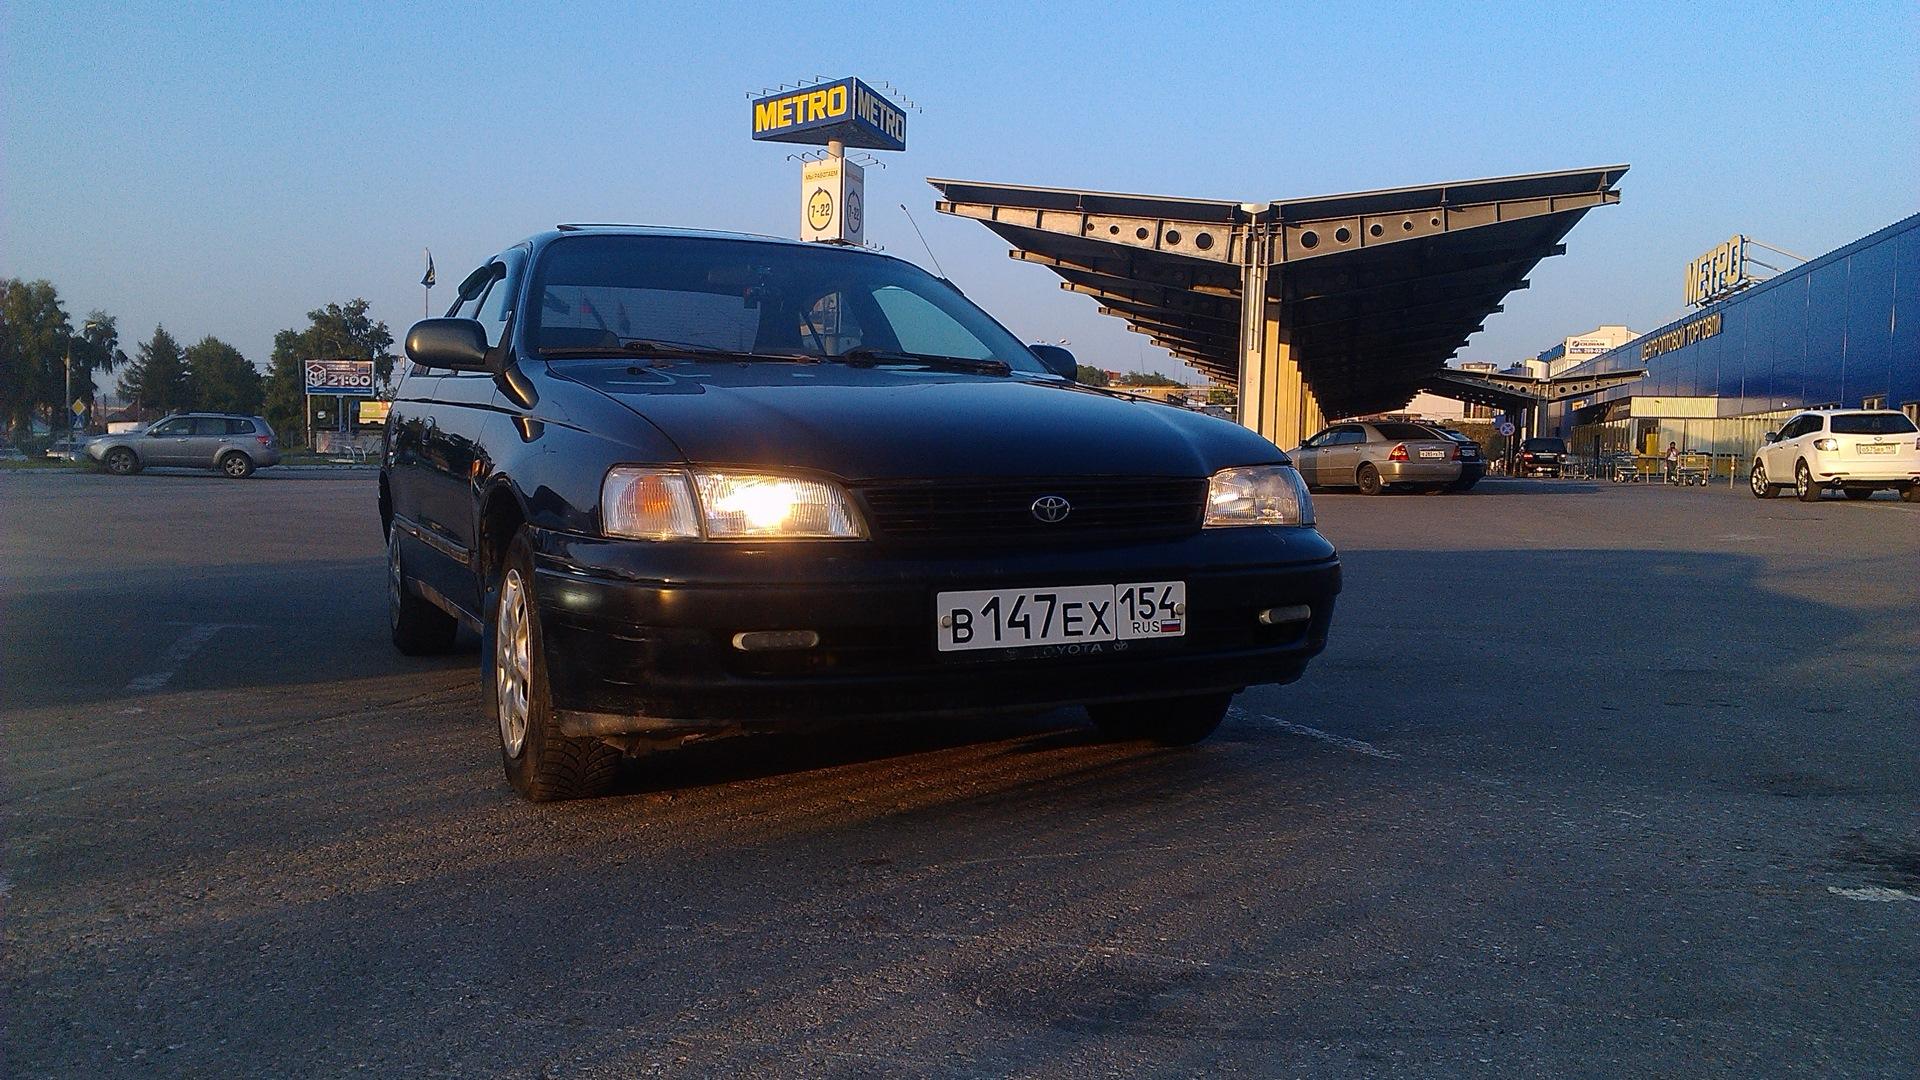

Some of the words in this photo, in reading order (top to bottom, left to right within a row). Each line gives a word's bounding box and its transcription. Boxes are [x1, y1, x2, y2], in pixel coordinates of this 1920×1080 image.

[755, 85, 847, 133] METRO
[857, 86, 905, 142] METRO
[811, 203, 830, 218] 7-22
[1684, 234, 1743, 306] МЕТРО
[327, 374, 371, 386] 21:00
[1119, 586, 1176, 621] 154
[1132, 620, 1160, 634] RUS
